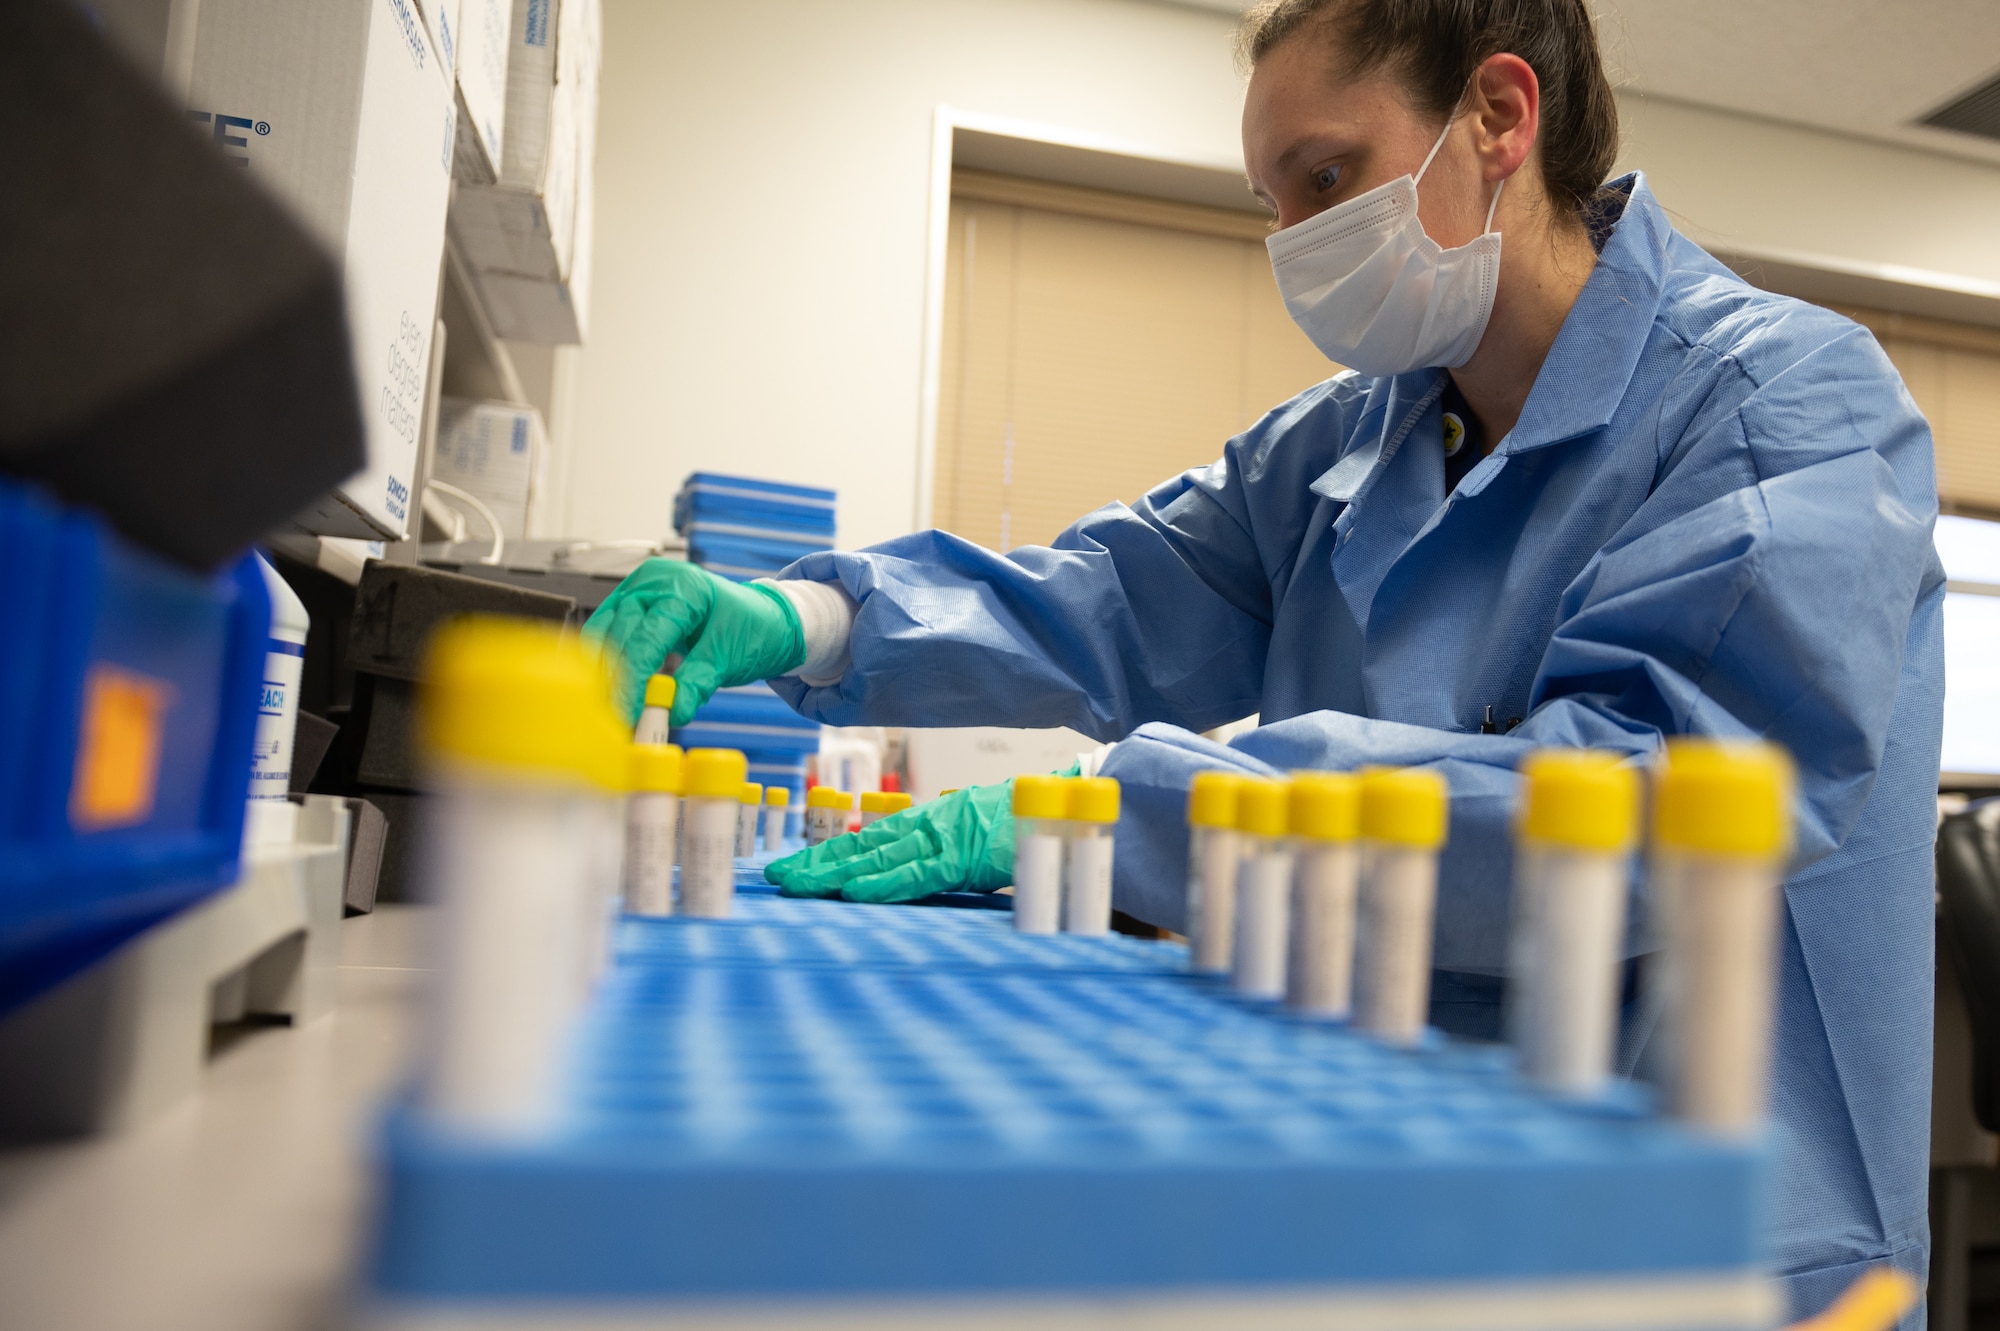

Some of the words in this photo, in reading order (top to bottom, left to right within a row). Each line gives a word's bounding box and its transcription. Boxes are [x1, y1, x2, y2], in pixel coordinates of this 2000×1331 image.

[400, 309, 425, 369] every
[387, 338, 420, 403] degree
[380, 385, 416, 445] matters
